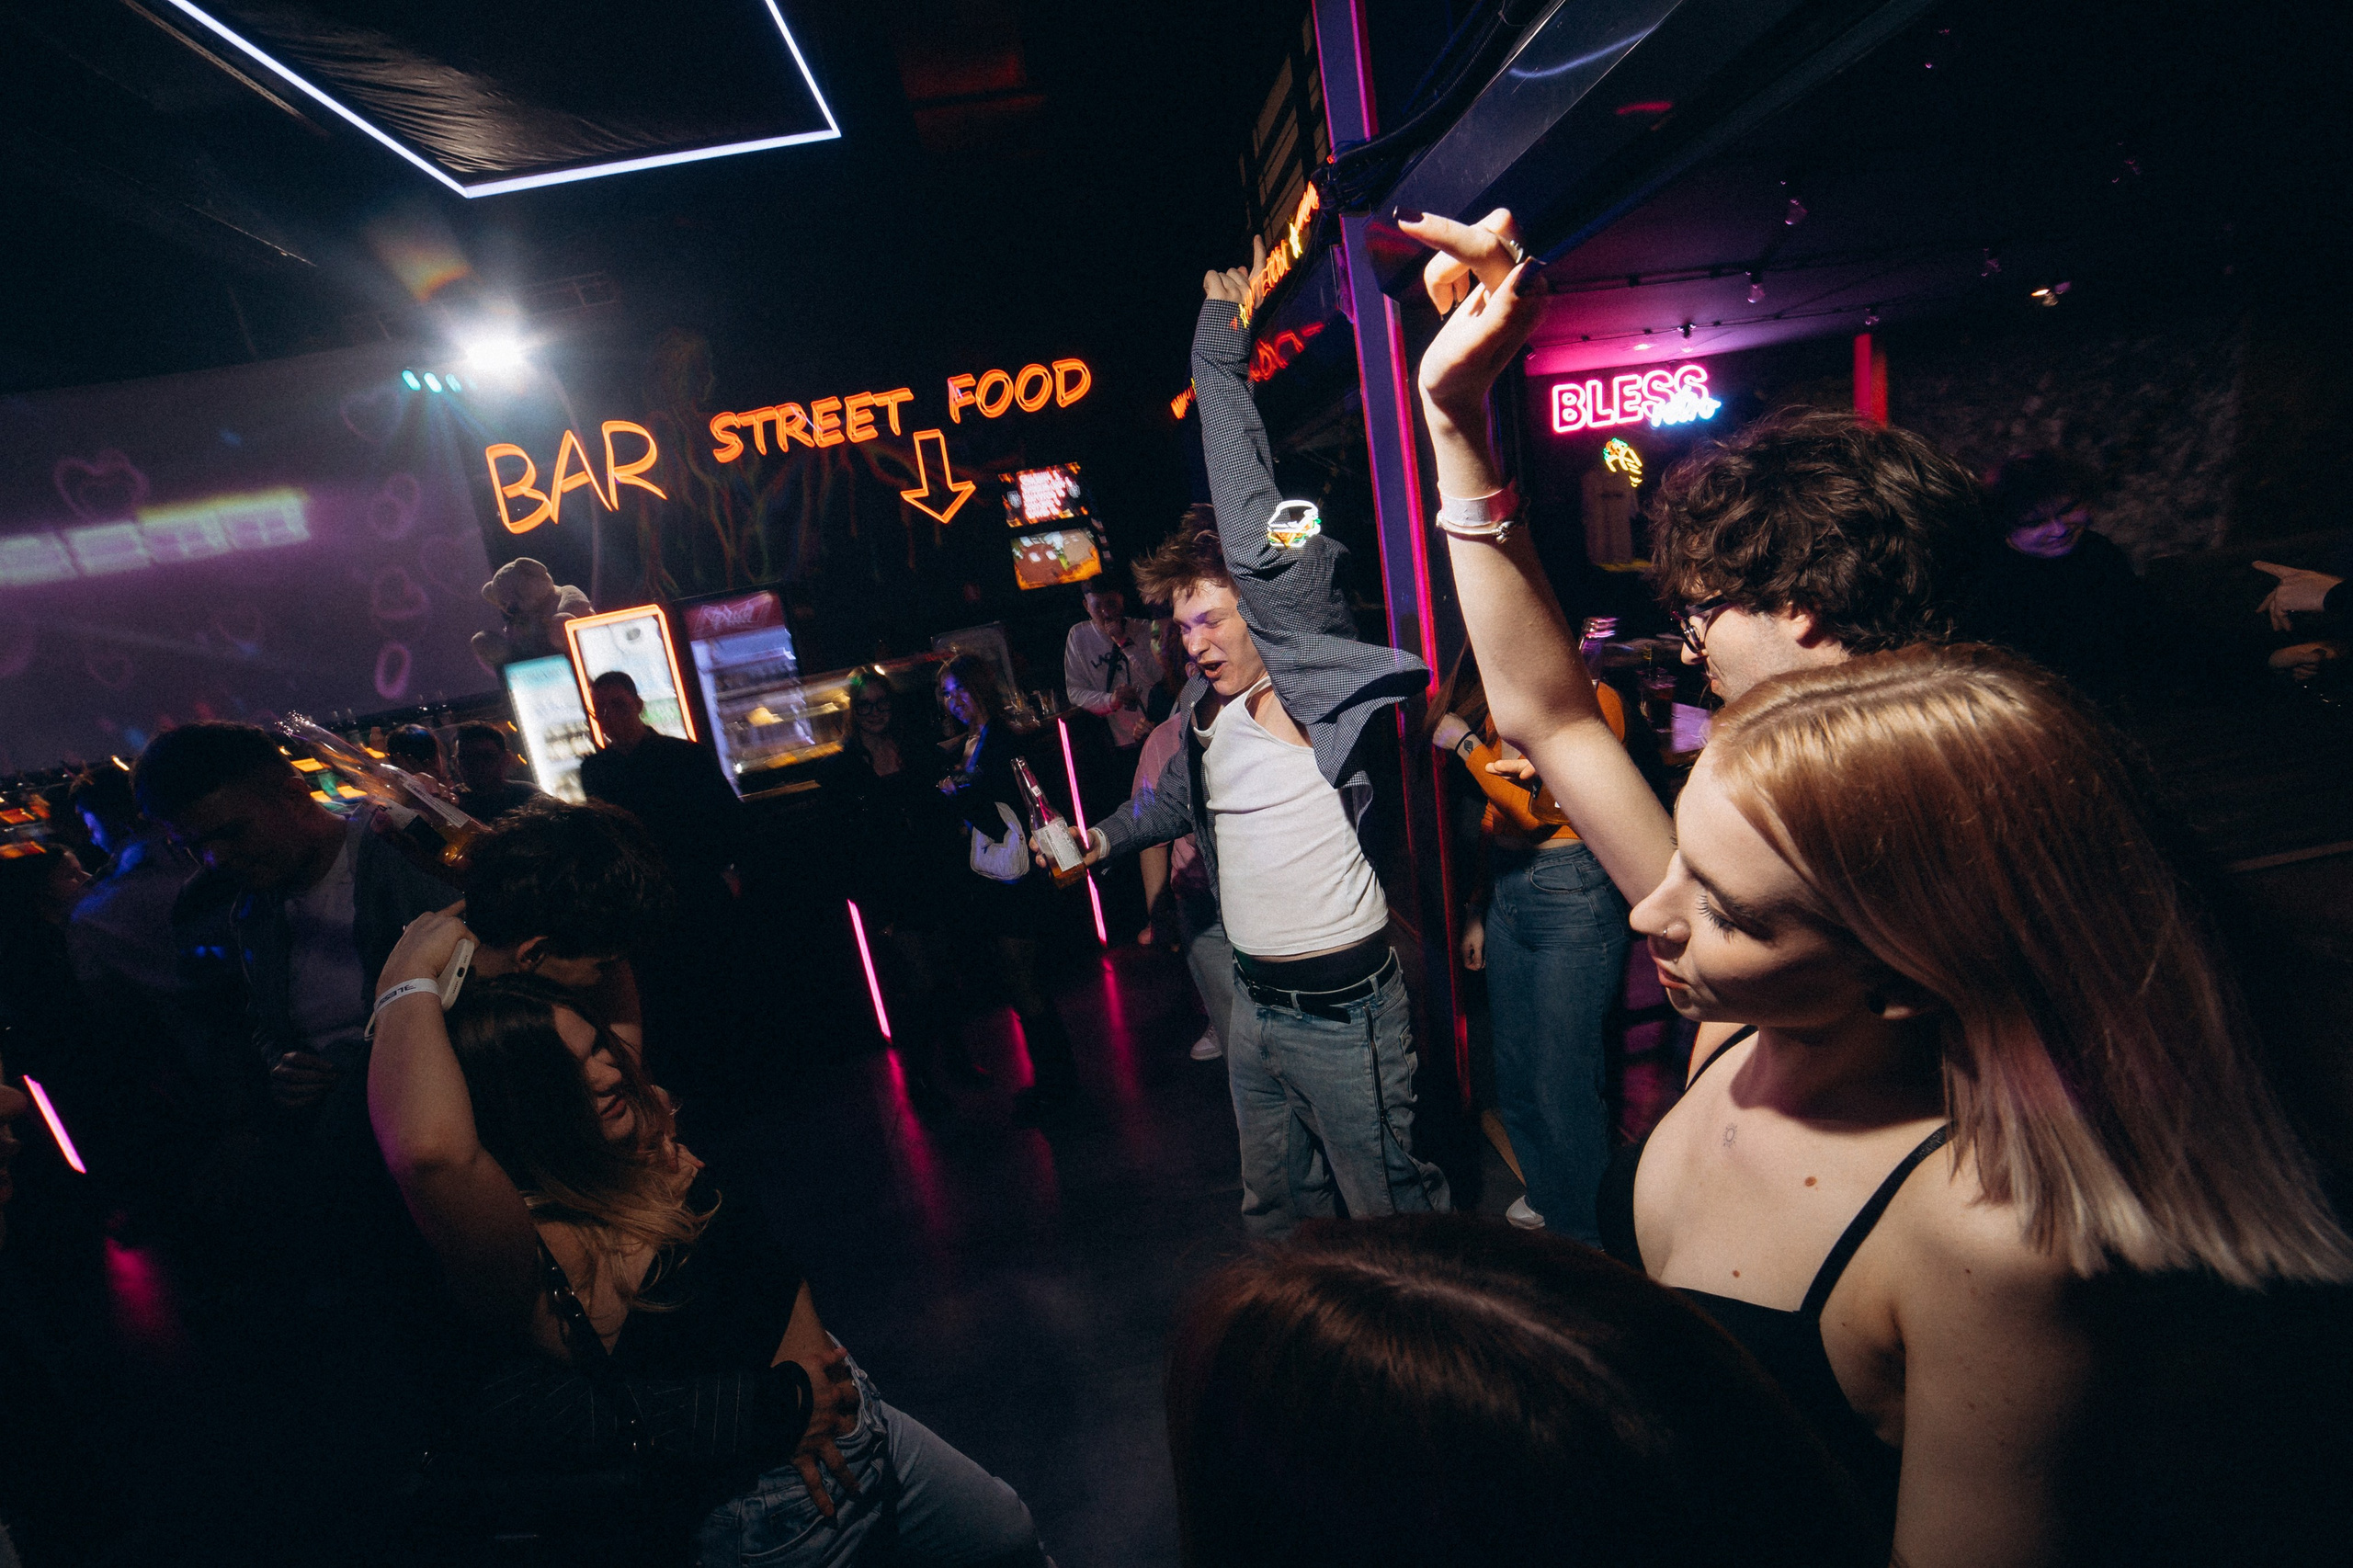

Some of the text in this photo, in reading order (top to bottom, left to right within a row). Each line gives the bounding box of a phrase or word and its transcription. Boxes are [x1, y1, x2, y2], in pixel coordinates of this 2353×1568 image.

[709, 387, 915, 464] STREET
[947, 358, 1092, 425] FOOD
[1552, 364, 1710, 434] BLESS
[484, 419, 668, 535] BAR
